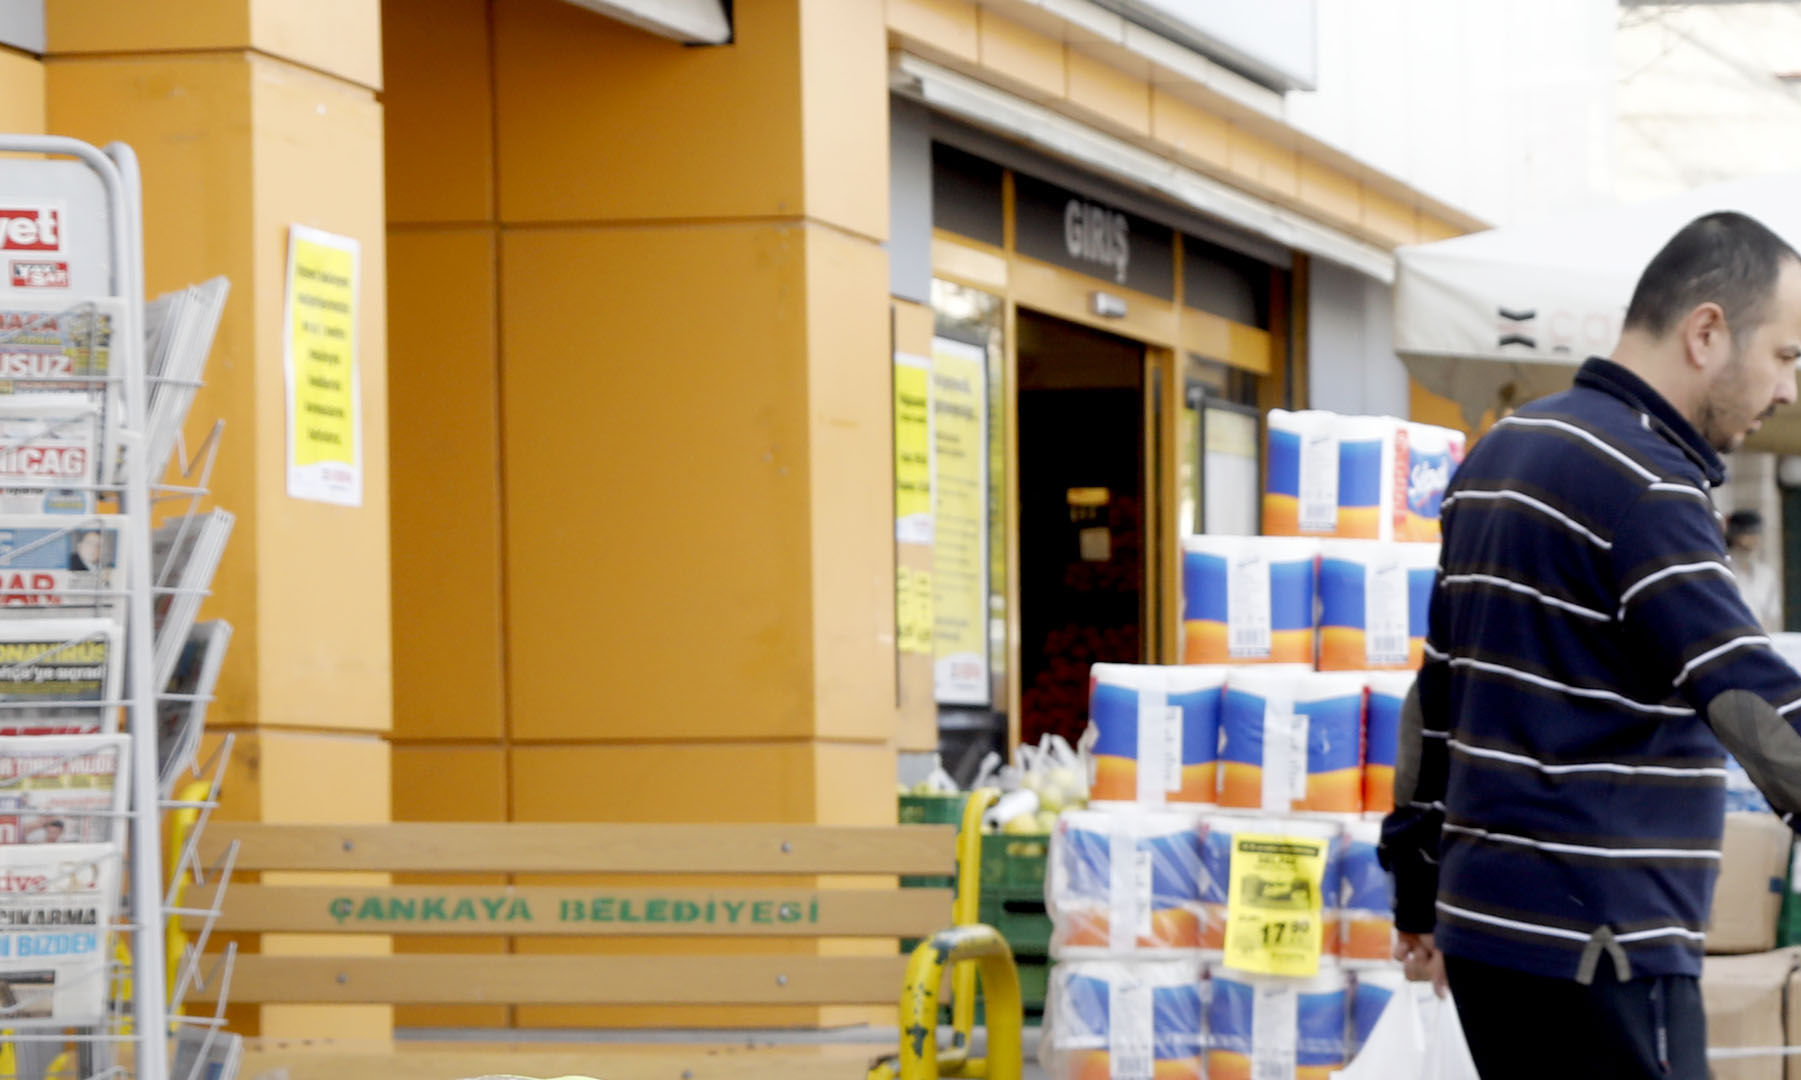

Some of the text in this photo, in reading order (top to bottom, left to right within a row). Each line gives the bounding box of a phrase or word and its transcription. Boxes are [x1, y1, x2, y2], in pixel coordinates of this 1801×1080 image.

[329, 896, 819, 925] ÇANKAYA BELEDİYESİ
[1262, 922, 1285, 944] 17
